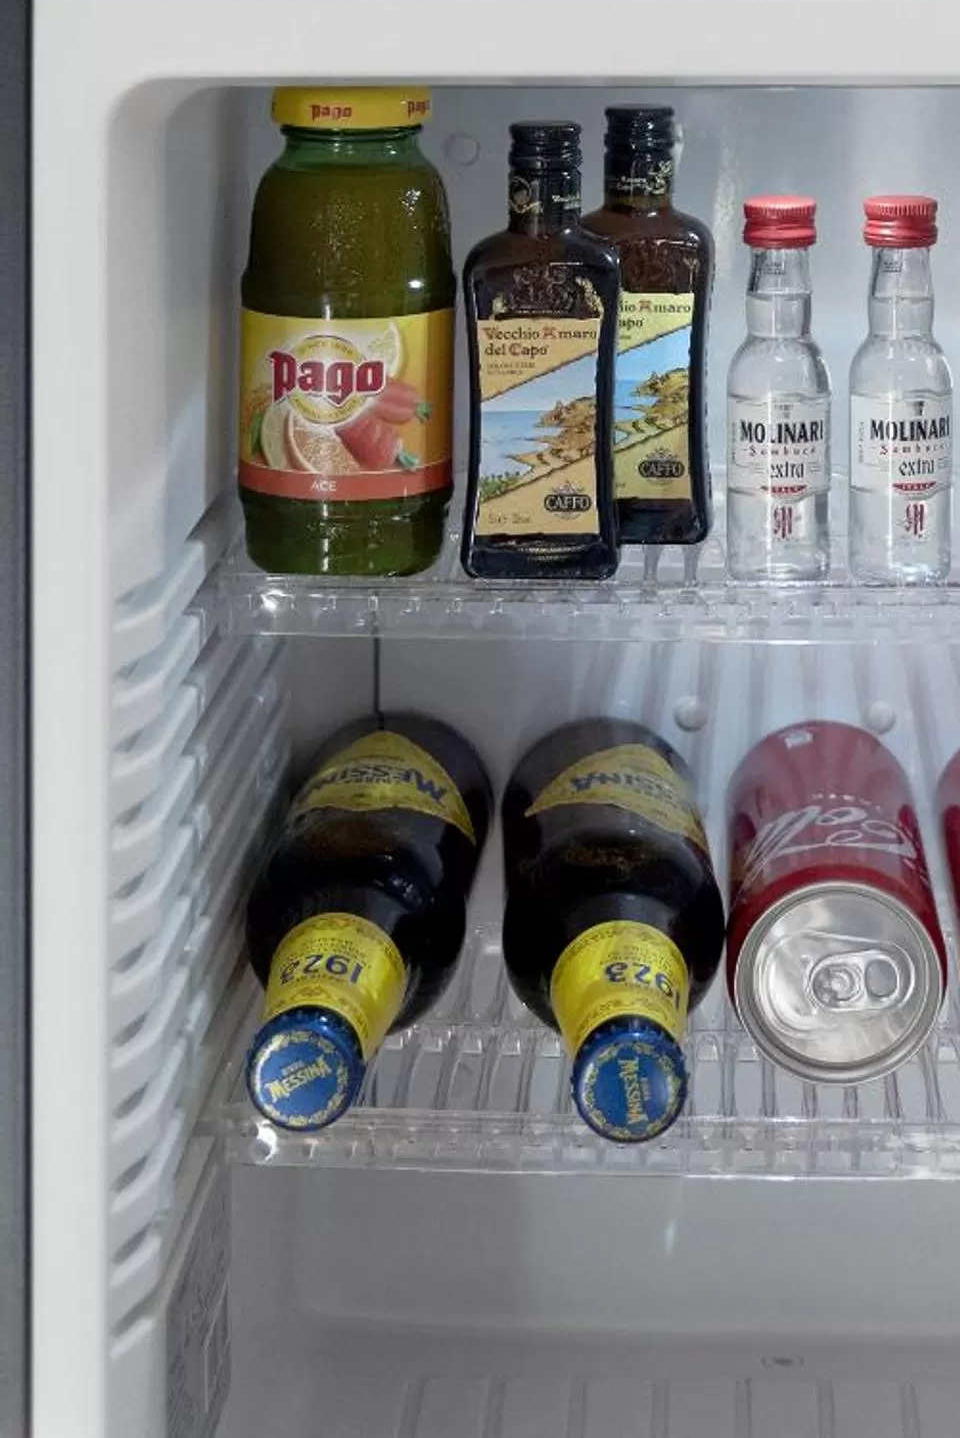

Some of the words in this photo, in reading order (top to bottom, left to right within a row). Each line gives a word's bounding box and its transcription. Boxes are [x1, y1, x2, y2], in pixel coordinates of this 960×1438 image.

[618, 317, 645, 332] apo
[482, 326, 540, 341] Vecchio
[484, 342, 506, 356] del
[508, 342, 549, 359] Capo
[740, 419, 824, 445] MOLINARI
[869, 414, 950, 442] MOLINARI
[640, 462, 682, 477] CAFFO
[899, 458, 935, 477] extra
[310, 480, 337, 492] ACE
[546, 496, 590, 510] CAFFO
[264, 1055, 332, 1102] MESSINA
